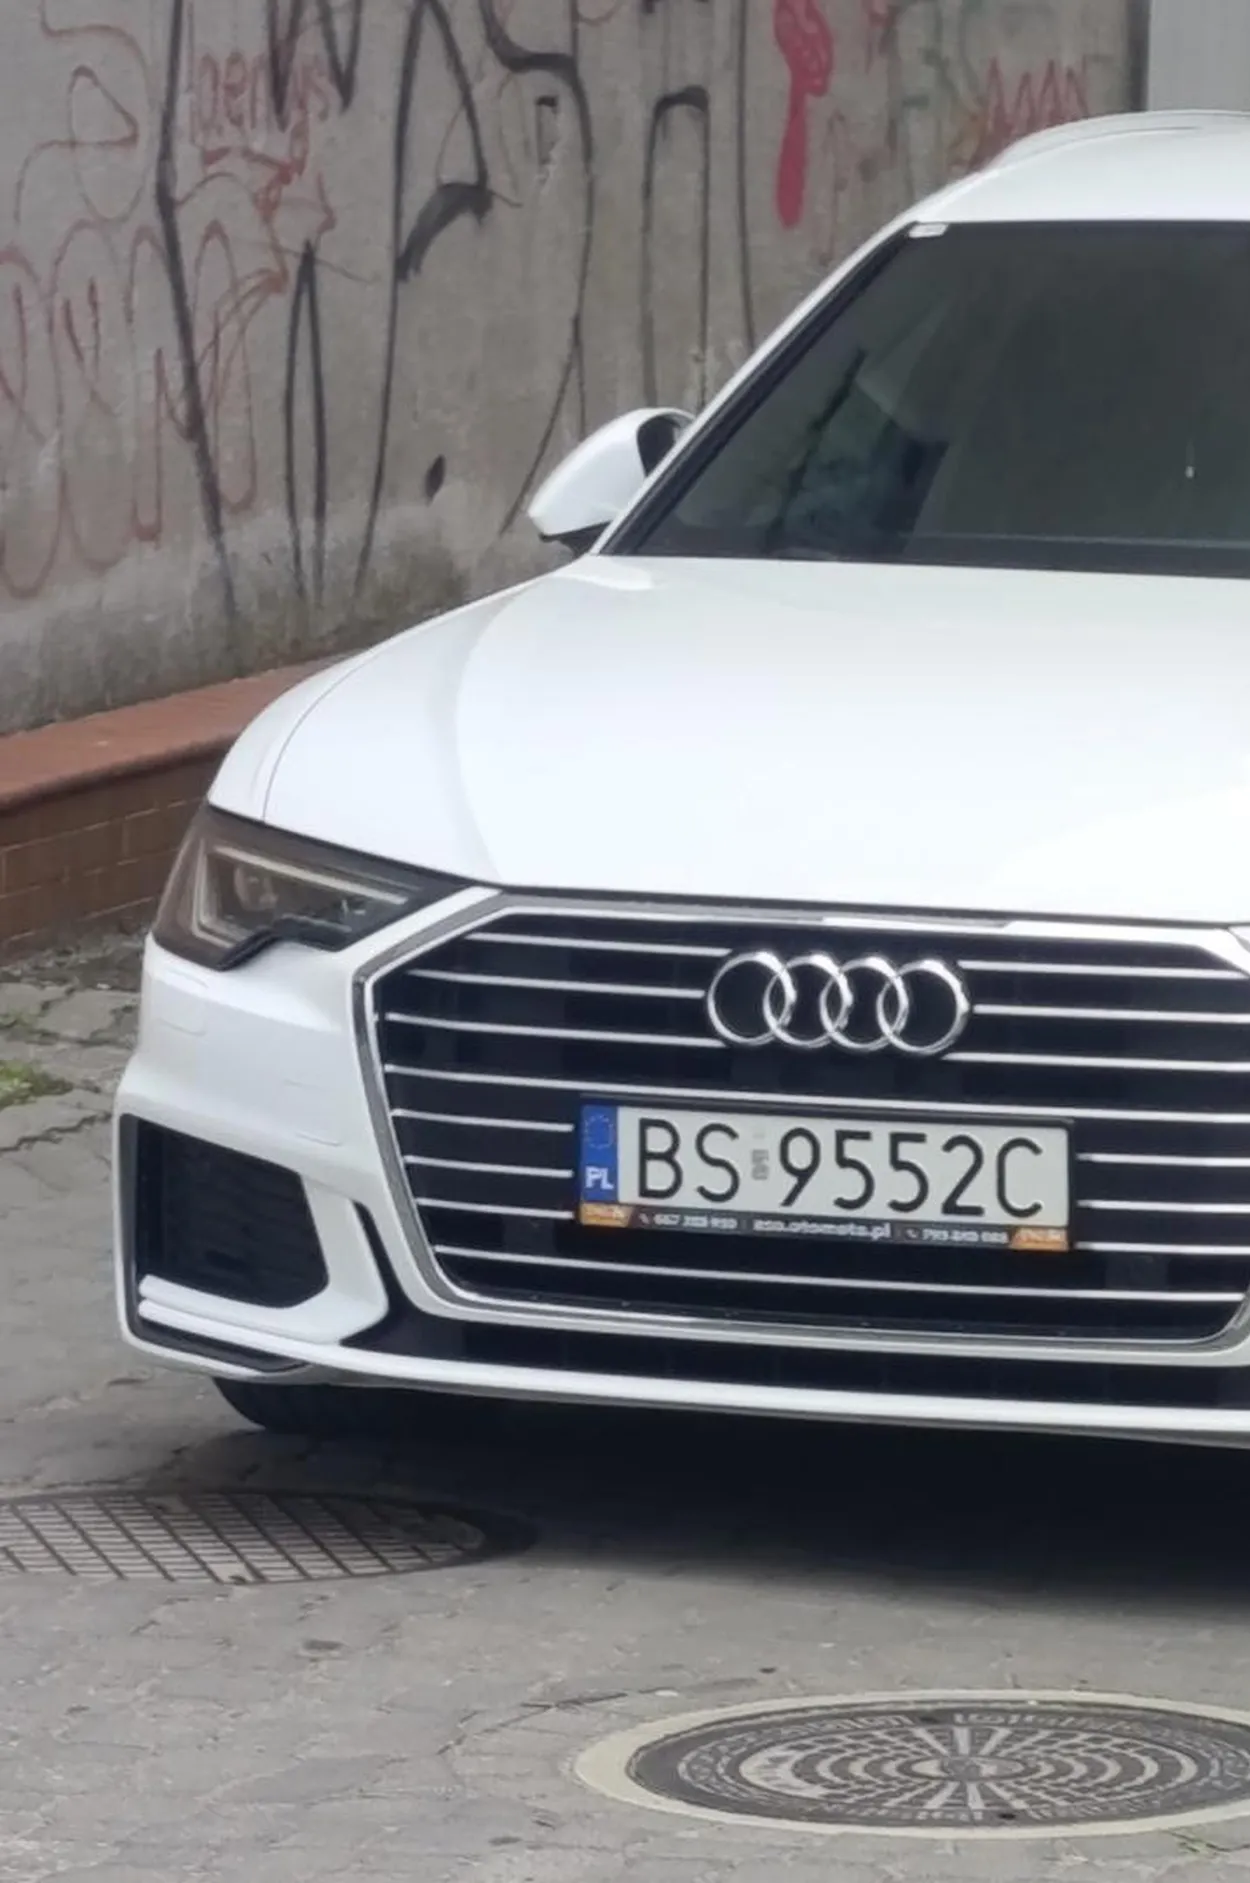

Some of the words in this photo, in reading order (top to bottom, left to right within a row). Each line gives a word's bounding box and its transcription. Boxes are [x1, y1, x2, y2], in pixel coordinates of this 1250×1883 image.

[585, 1166, 614, 1190] PL
[638, 1117, 740, 1202] BS
[778, 1127, 1043, 1218] 9552C
